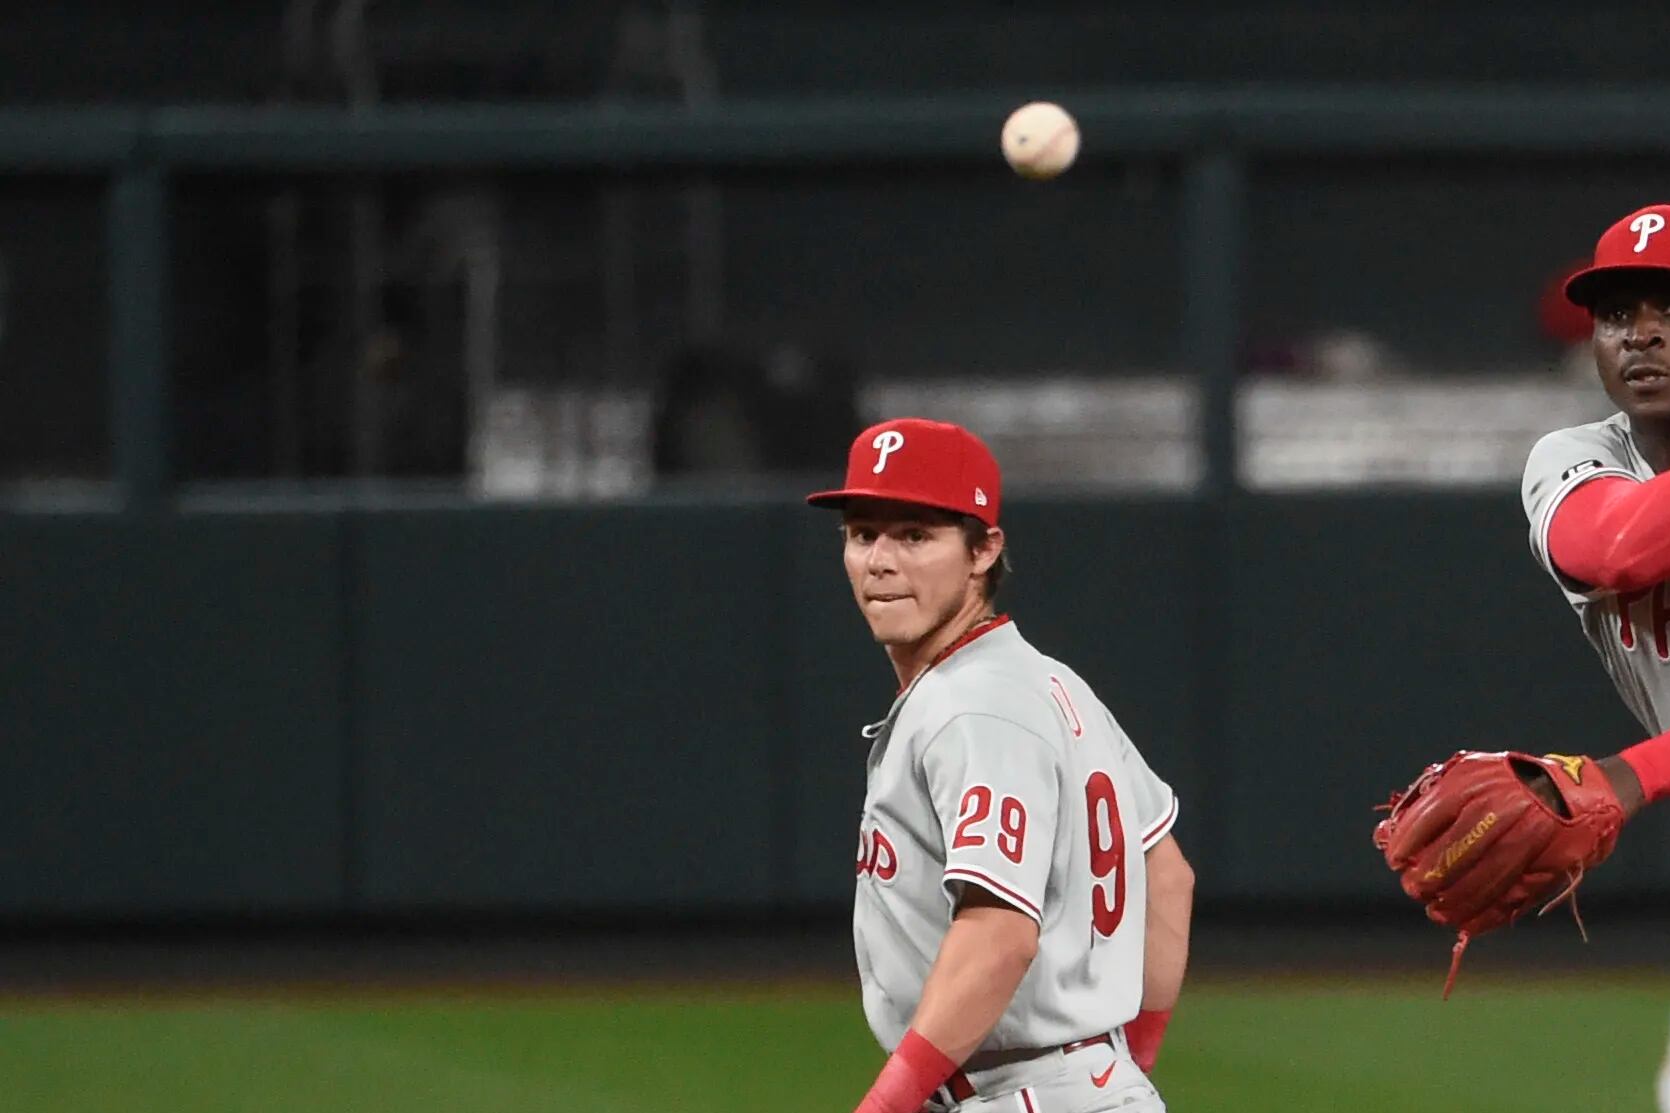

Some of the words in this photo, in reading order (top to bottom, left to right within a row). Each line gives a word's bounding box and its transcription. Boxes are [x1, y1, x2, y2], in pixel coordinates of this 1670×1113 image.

[1629, 212, 1666, 253] P
[872, 430, 904, 474] P
[951, 783, 1027, 865] 29
